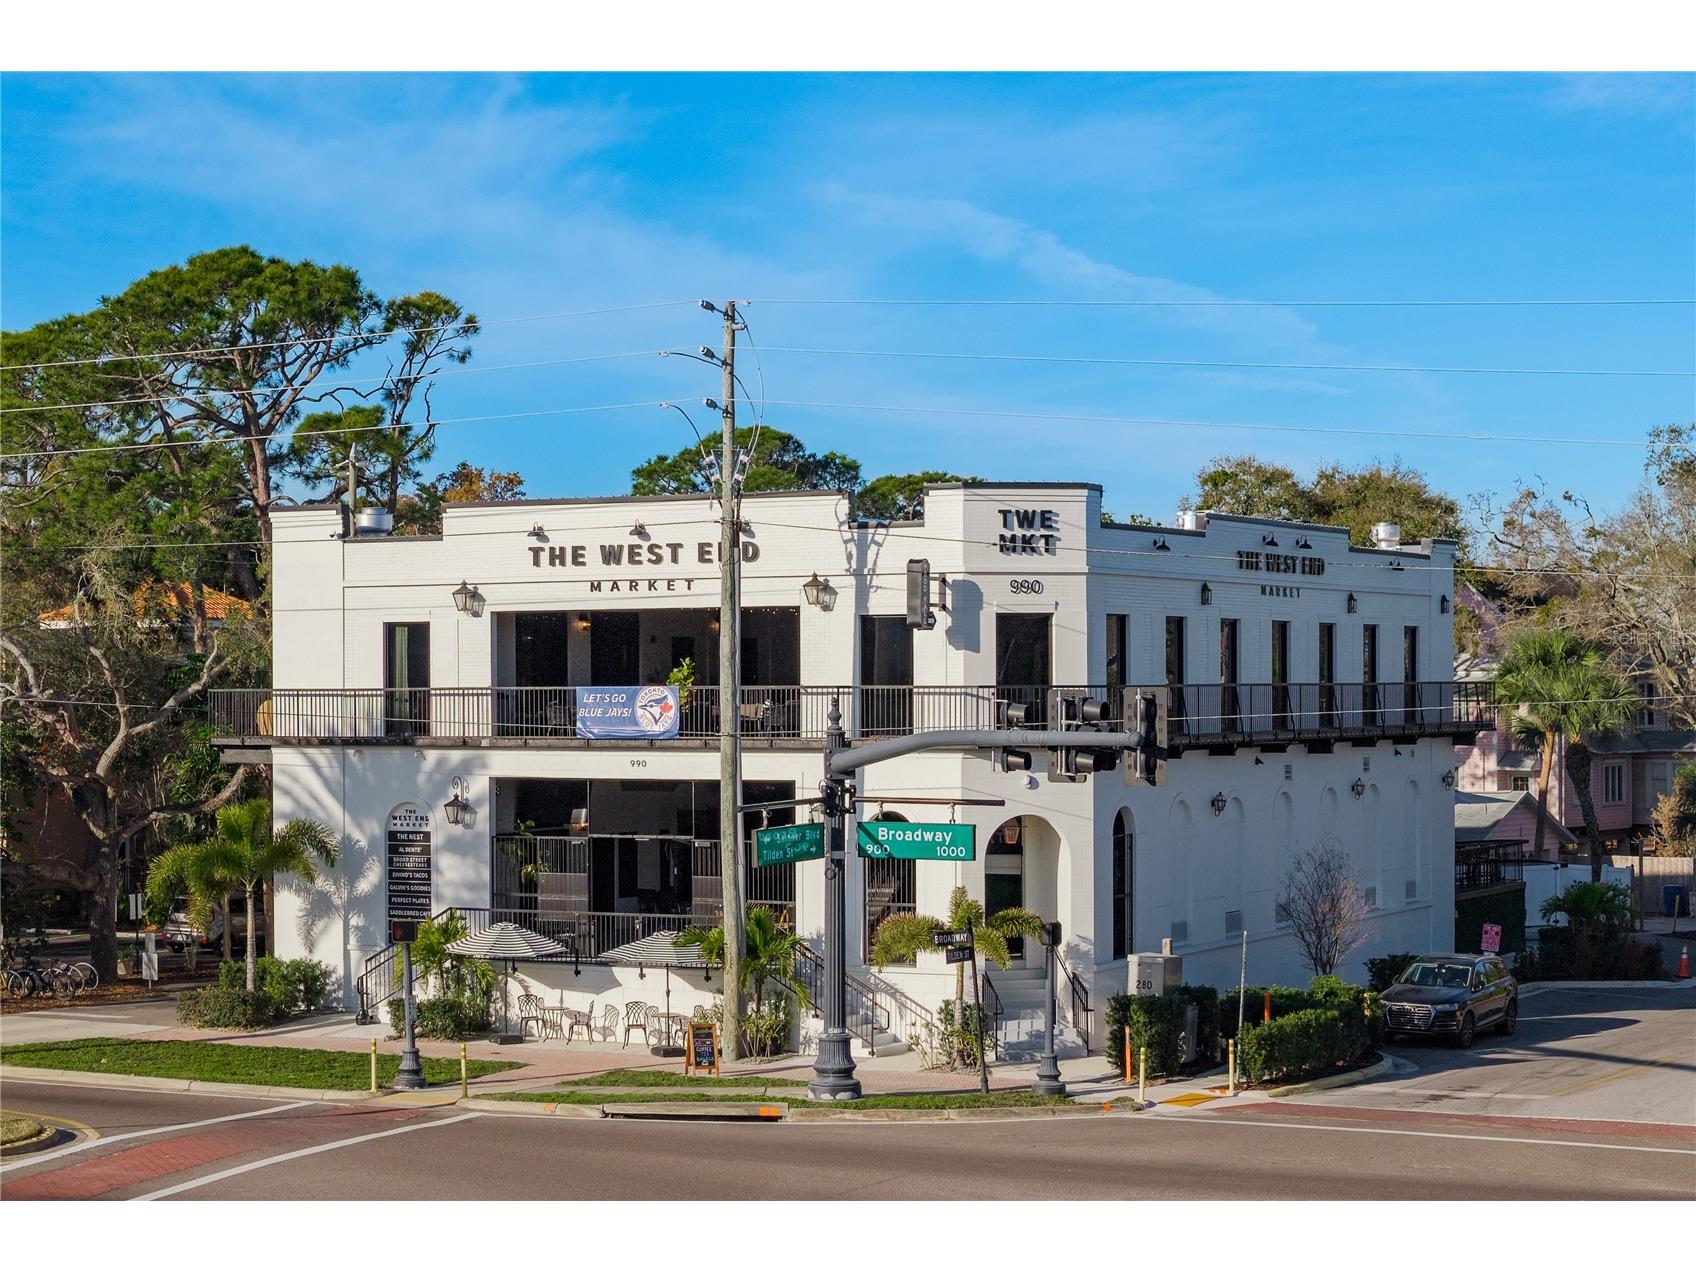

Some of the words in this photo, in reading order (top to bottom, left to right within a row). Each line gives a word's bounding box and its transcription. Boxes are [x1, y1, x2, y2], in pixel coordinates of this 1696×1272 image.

[998, 510, 1058, 530] TWE
[999, 534, 1058, 554] MKT
[528, 546, 587, 567] THE
[600, 543, 684, 566] WEST
[698, 541, 760, 564] ED
[1237, 551, 1262, 571] THE
[1265, 553, 1298, 574] WEST
[1301, 556, 1325, 576] END
[590, 579, 695, 592] MARKET
[1010, 580, 1044, 595] 990
[1260, 585, 1300, 598] MARKET
[583, 693, 610, 703] LET'S
[611, 693, 627, 703] GO
[639, 687, 666, 703] TORONTO
[579, 708, 604, 717] BLUE
[605, 708, 632, 717] JAYS!
[630, 759, 647, 768] 990
[805, 829, 820, 840] Blvd
[877, 826, 953, 844] Broadway
[763, 848, 784, 861] Tilden
[786, 847, 794, 858] St
[865, 844, 890, 854] 900
[936, 846, 966, 857] 1000
[934, 932, 967, 944] BROADWAY
[1136, 979, 1153, 990] 280
